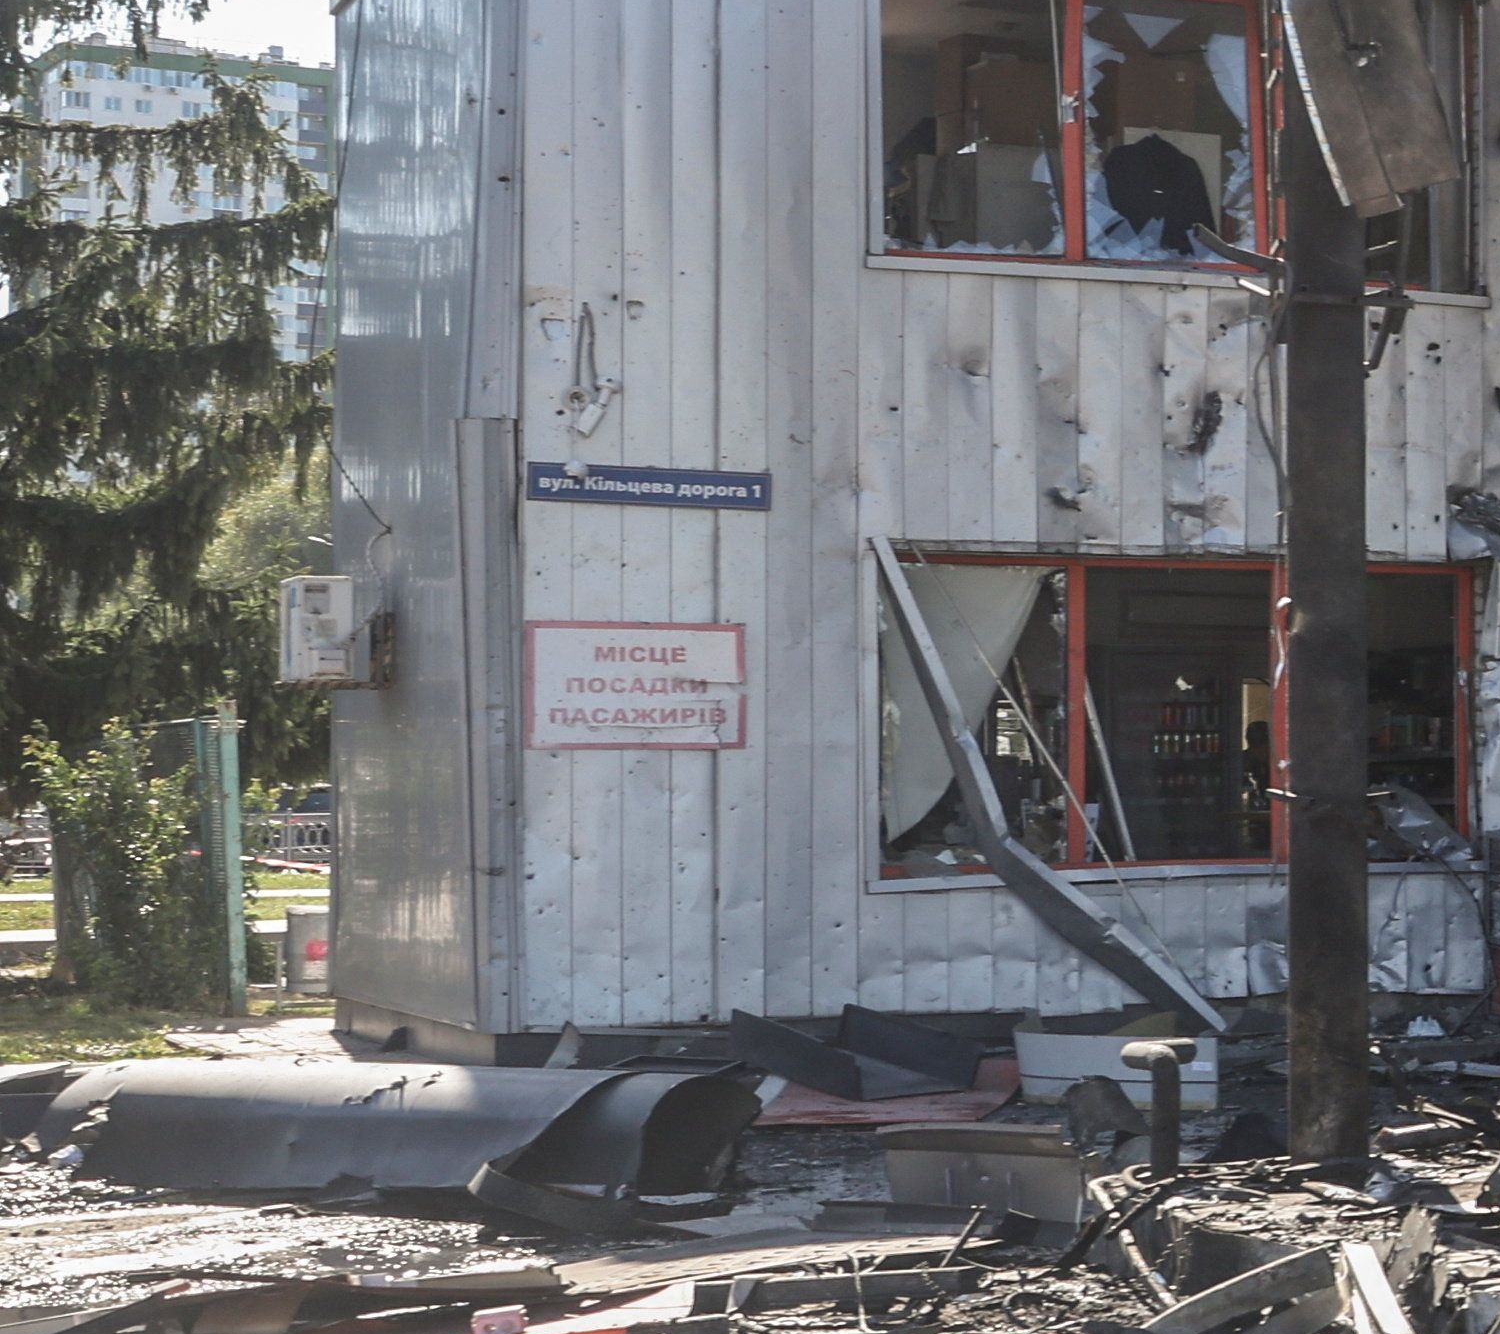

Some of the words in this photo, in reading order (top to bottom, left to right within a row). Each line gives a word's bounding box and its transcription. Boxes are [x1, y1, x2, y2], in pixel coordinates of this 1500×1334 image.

[538, 475, 581, 493] вул.
[585, 476, 674, 495] Кільцева
[677, 483, 748, 500] дорога
[752, 484, 762, 498] 1
[594, 645, 687, 666] МІСЦЕ
[566, 676, 709, 696] ПОСАДКИ
[550, 707, 727, 725] ПАСАЖИРІВ
